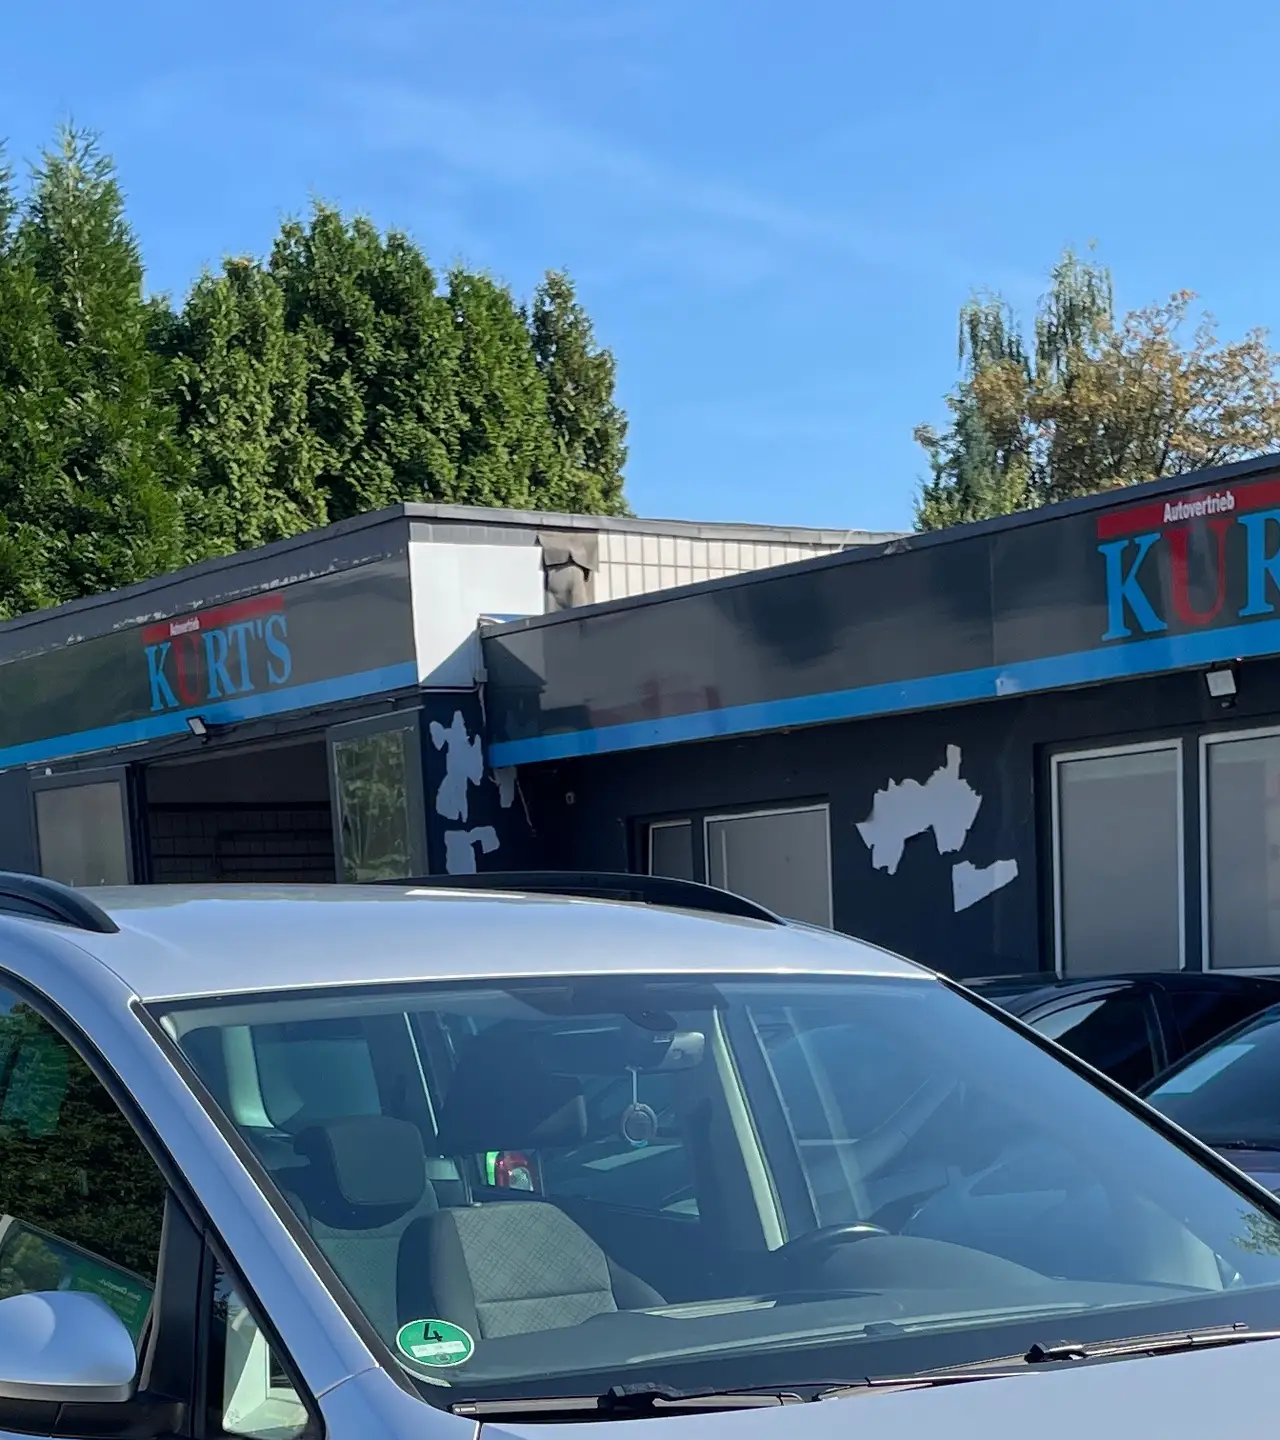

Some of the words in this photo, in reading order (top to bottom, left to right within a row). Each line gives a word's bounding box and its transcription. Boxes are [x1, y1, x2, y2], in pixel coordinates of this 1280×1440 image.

[1163, 490, 1236, 523] Autovertrieb
[144, 614, 292, 711] KURT'S
[423, 1323, 443, 1342] 4
